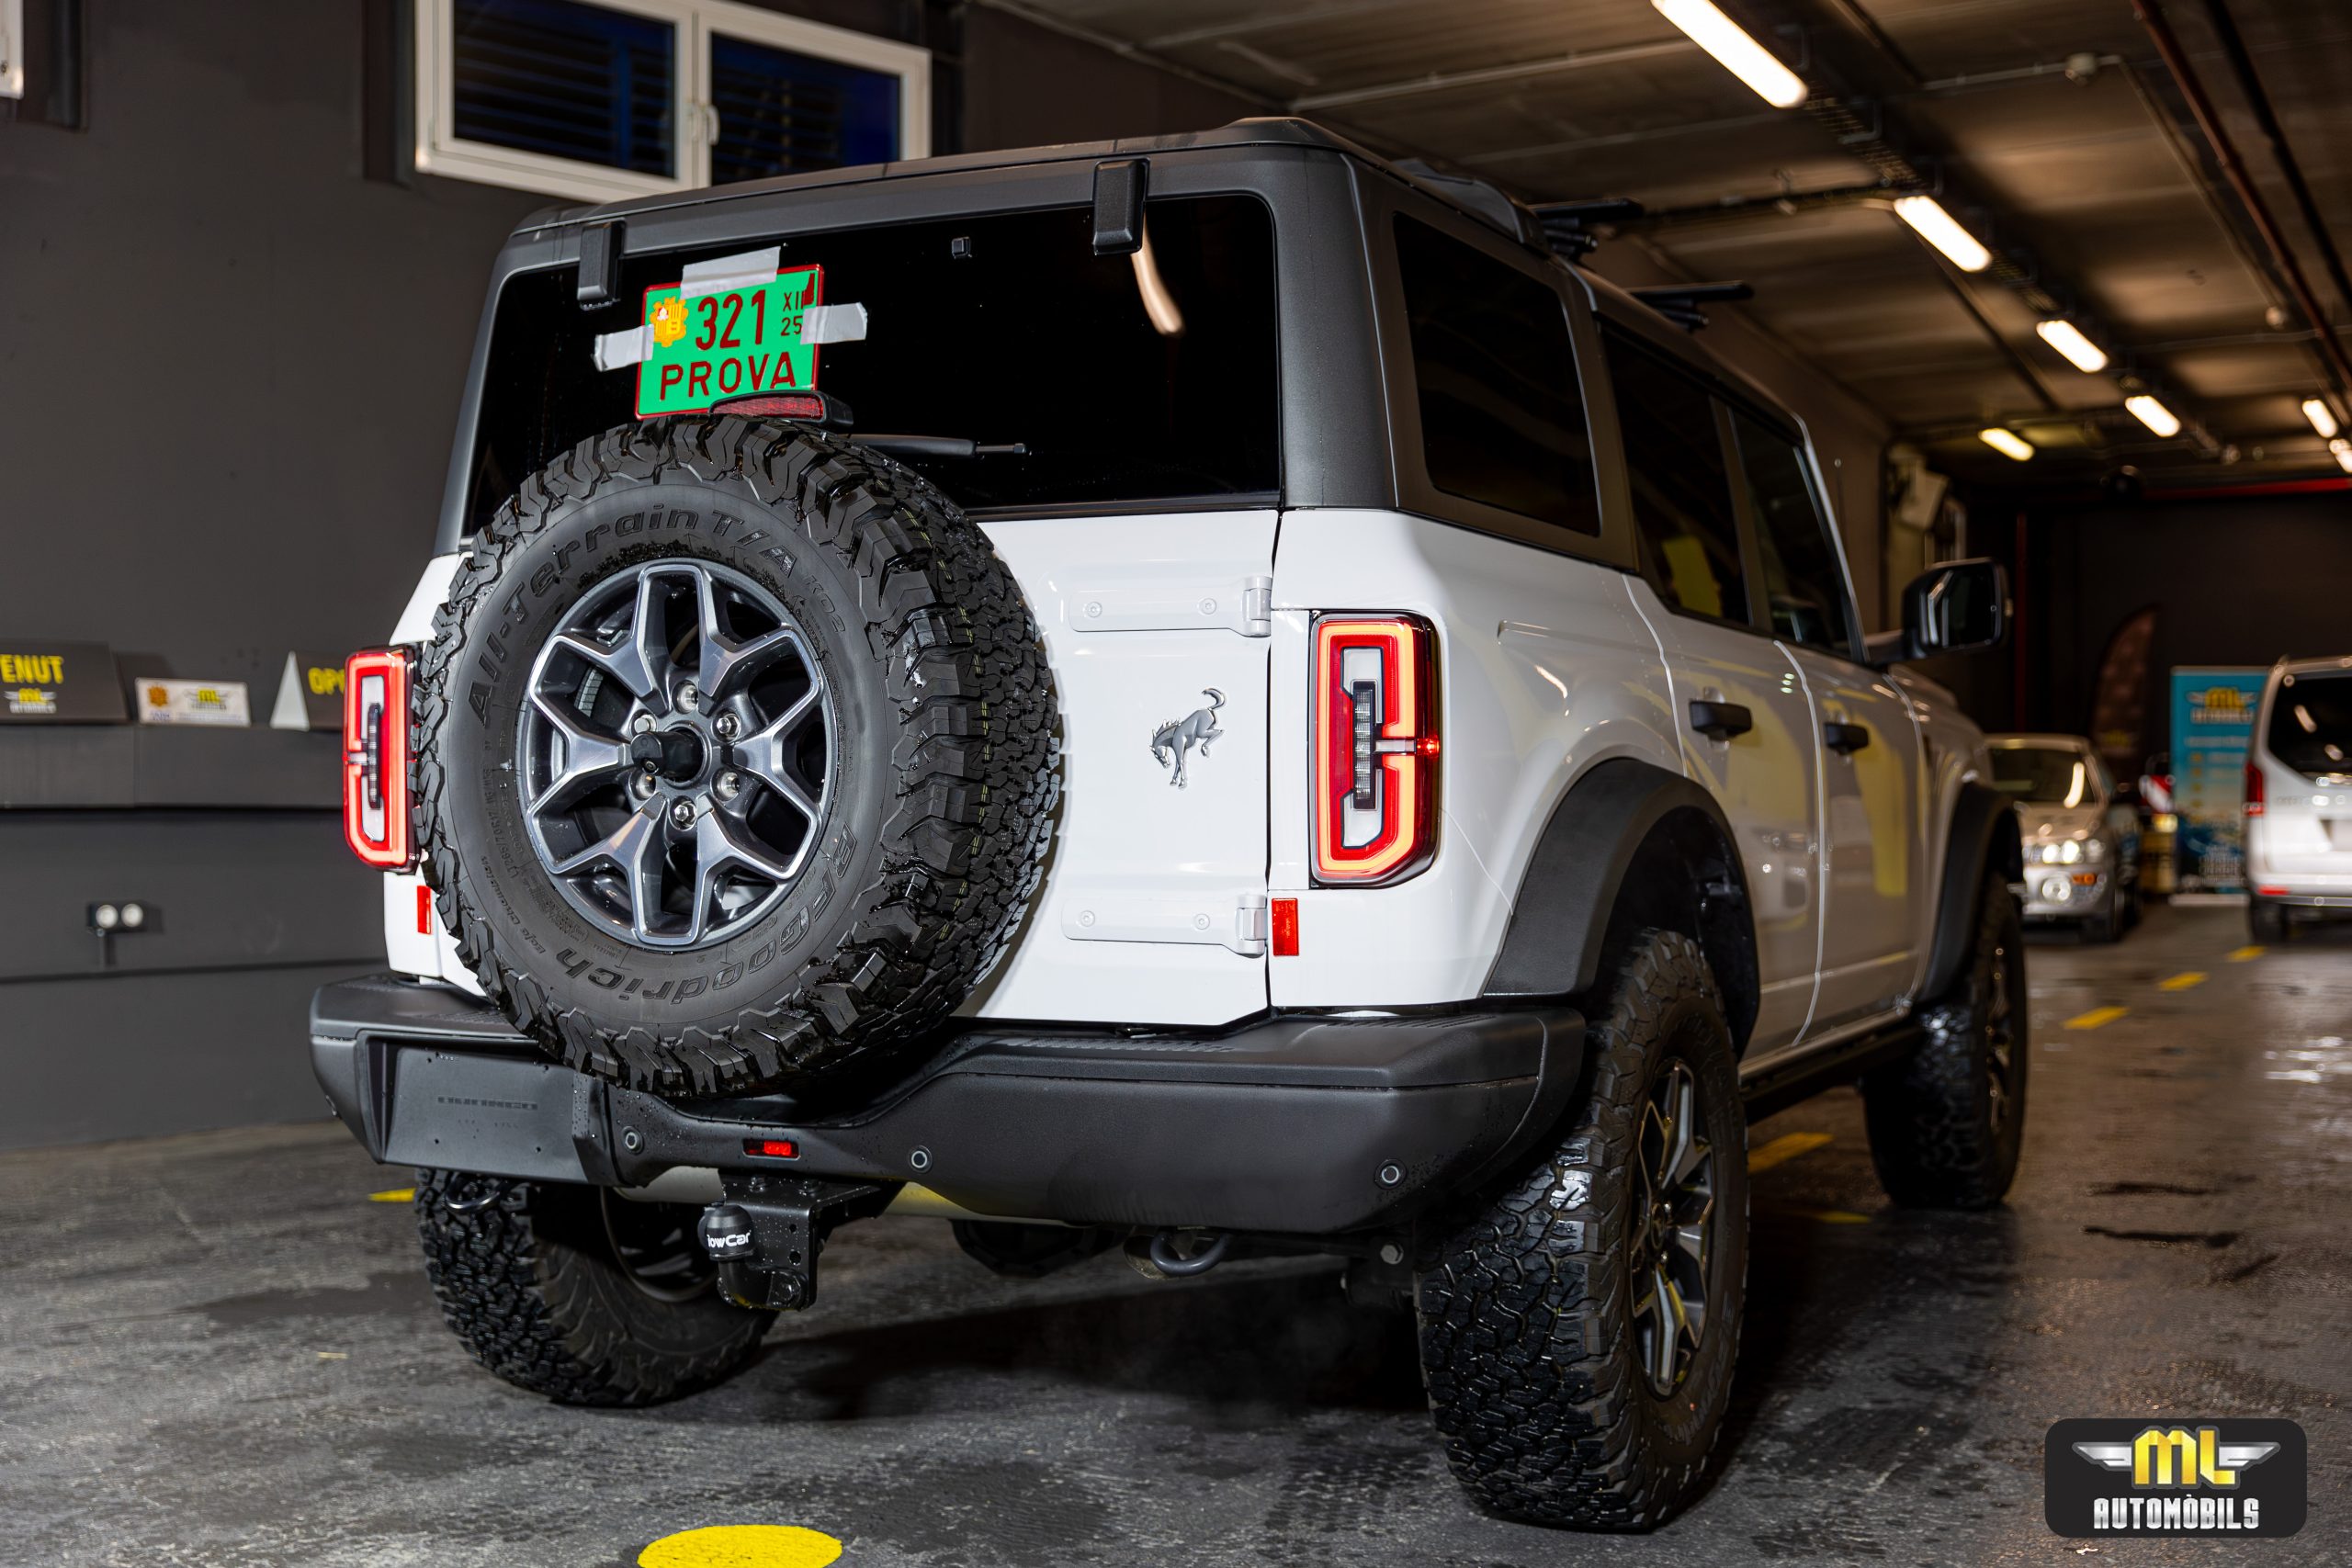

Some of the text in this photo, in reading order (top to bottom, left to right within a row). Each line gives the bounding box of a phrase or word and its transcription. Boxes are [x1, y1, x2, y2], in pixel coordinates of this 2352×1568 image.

[695, 290, 766, 350] 321
[781, 315, 803, 336] 25
[660, 352, 796, 400] PROVA
[468, 502, 699, 729] All-Terrain
[711, 509, 798, 579] T/A
[556, 823, 858, 1005] BFGoodrich
